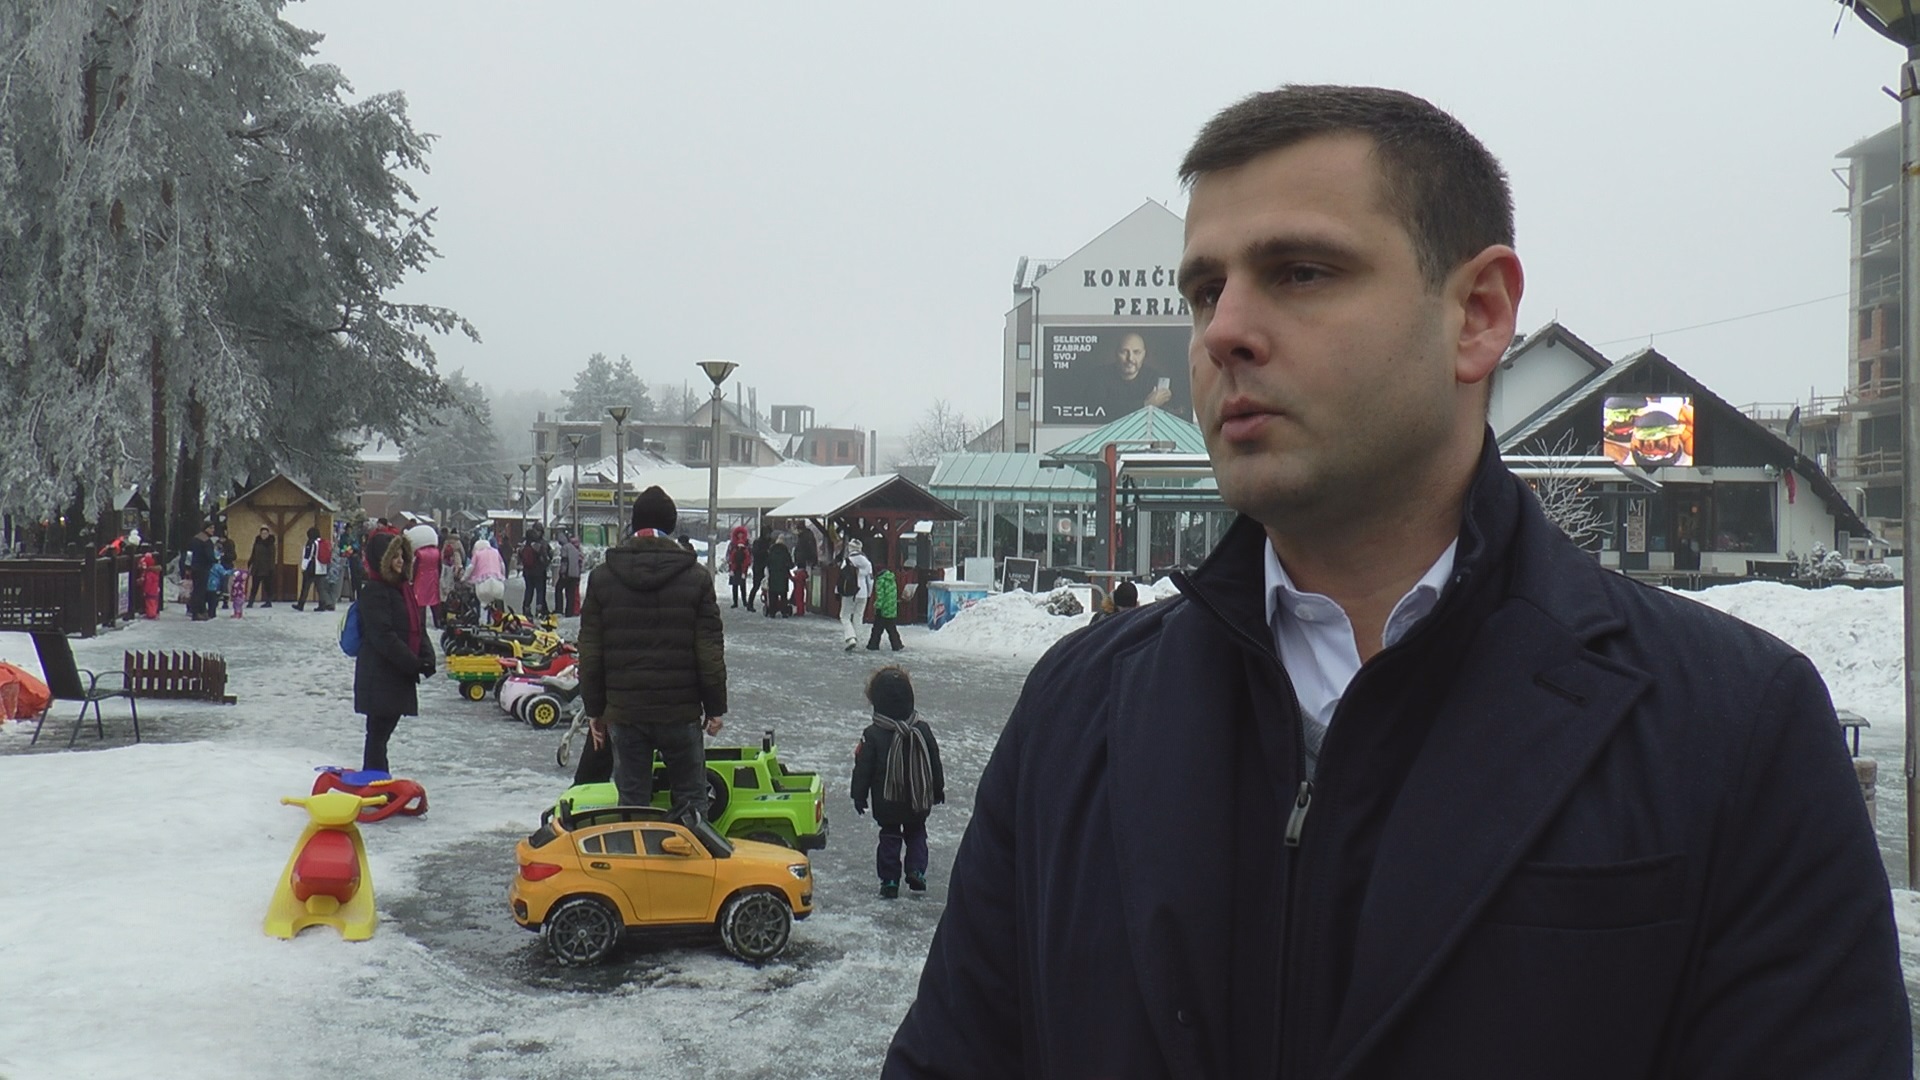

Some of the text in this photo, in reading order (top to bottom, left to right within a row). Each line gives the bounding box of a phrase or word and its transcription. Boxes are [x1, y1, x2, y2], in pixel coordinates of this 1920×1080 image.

[1083, 265, 1176, 287] KONAČI
[1113, 297, 1191, 316] PERLA
[1053, 335, 1098, 344] SELEKTOR
[1053, 344, 1092, 352] IZABRAO
[1053, 352, 1077, 361] SVOJ
[1053, 361, 1070, 369] TIM
[1052, 405, 1106, 417] TESLA
